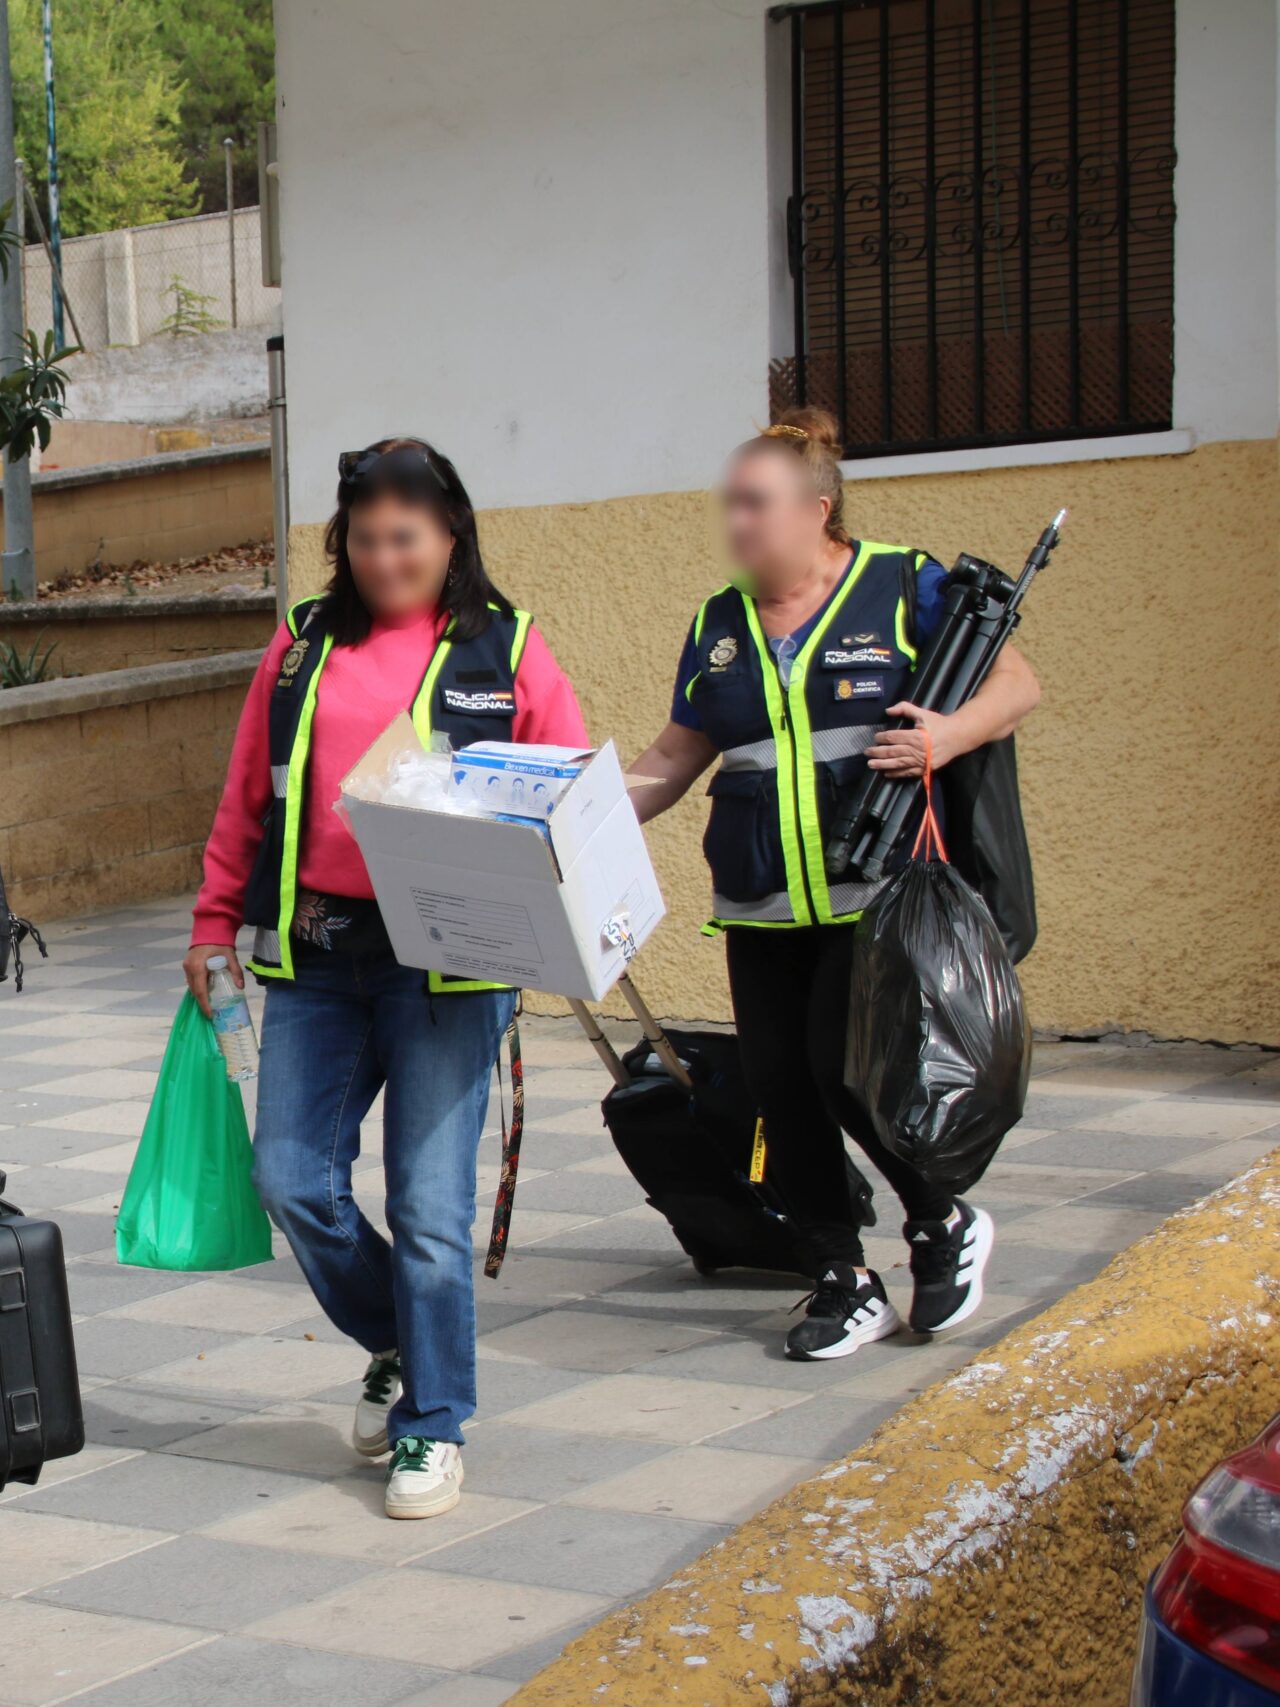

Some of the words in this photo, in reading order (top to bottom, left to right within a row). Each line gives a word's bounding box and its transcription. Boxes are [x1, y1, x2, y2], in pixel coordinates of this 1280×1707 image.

[825, 648, 874, 657] POLICIA
[825, 655, 891, 663] NACIONAL
[445, 690, 496, 701] POLICIA
[447, 698, 513, 709] NACIONAL
[528, 766, 555, 777] medical
